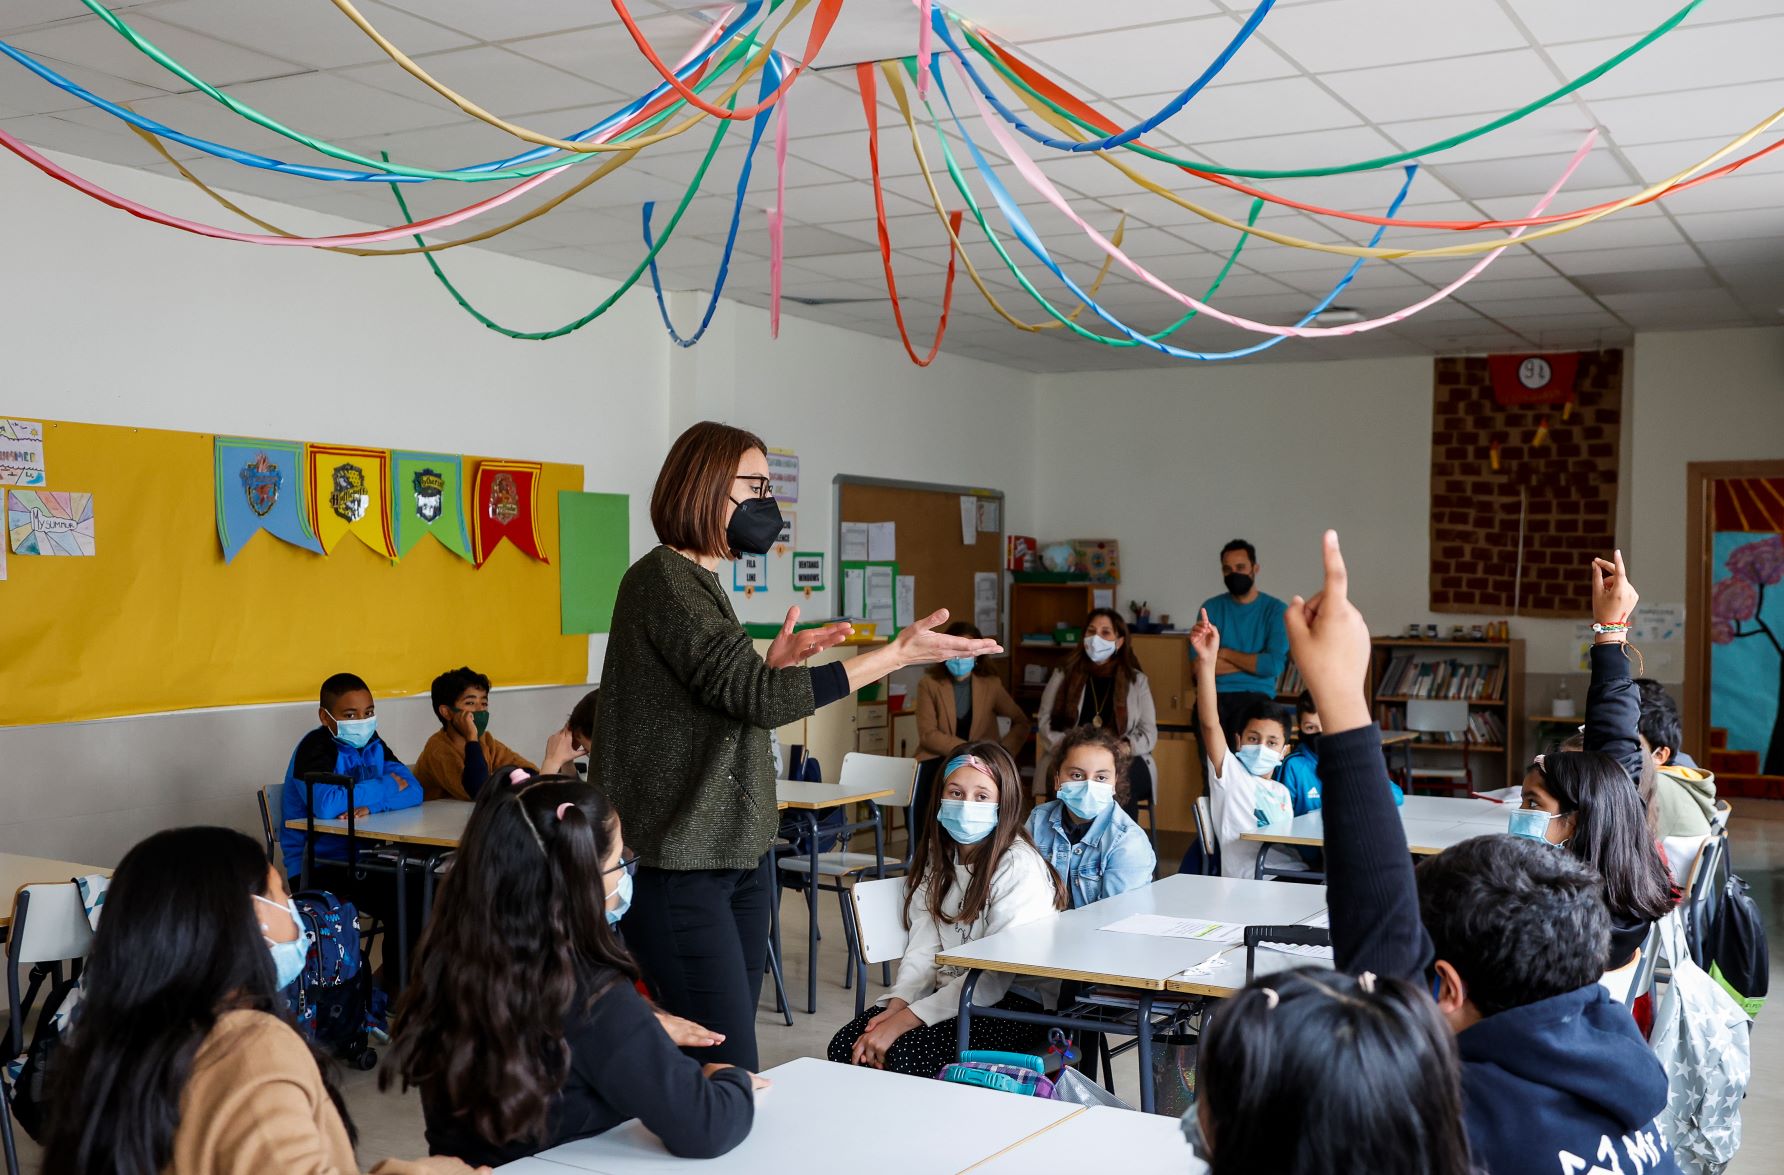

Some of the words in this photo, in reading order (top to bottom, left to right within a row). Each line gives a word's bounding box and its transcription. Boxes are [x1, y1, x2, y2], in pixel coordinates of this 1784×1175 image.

[746, 560, 756, 568] FILA
[746, 574, 756, 582] LINE
[798, 574, 819, 582] WINDOWS
